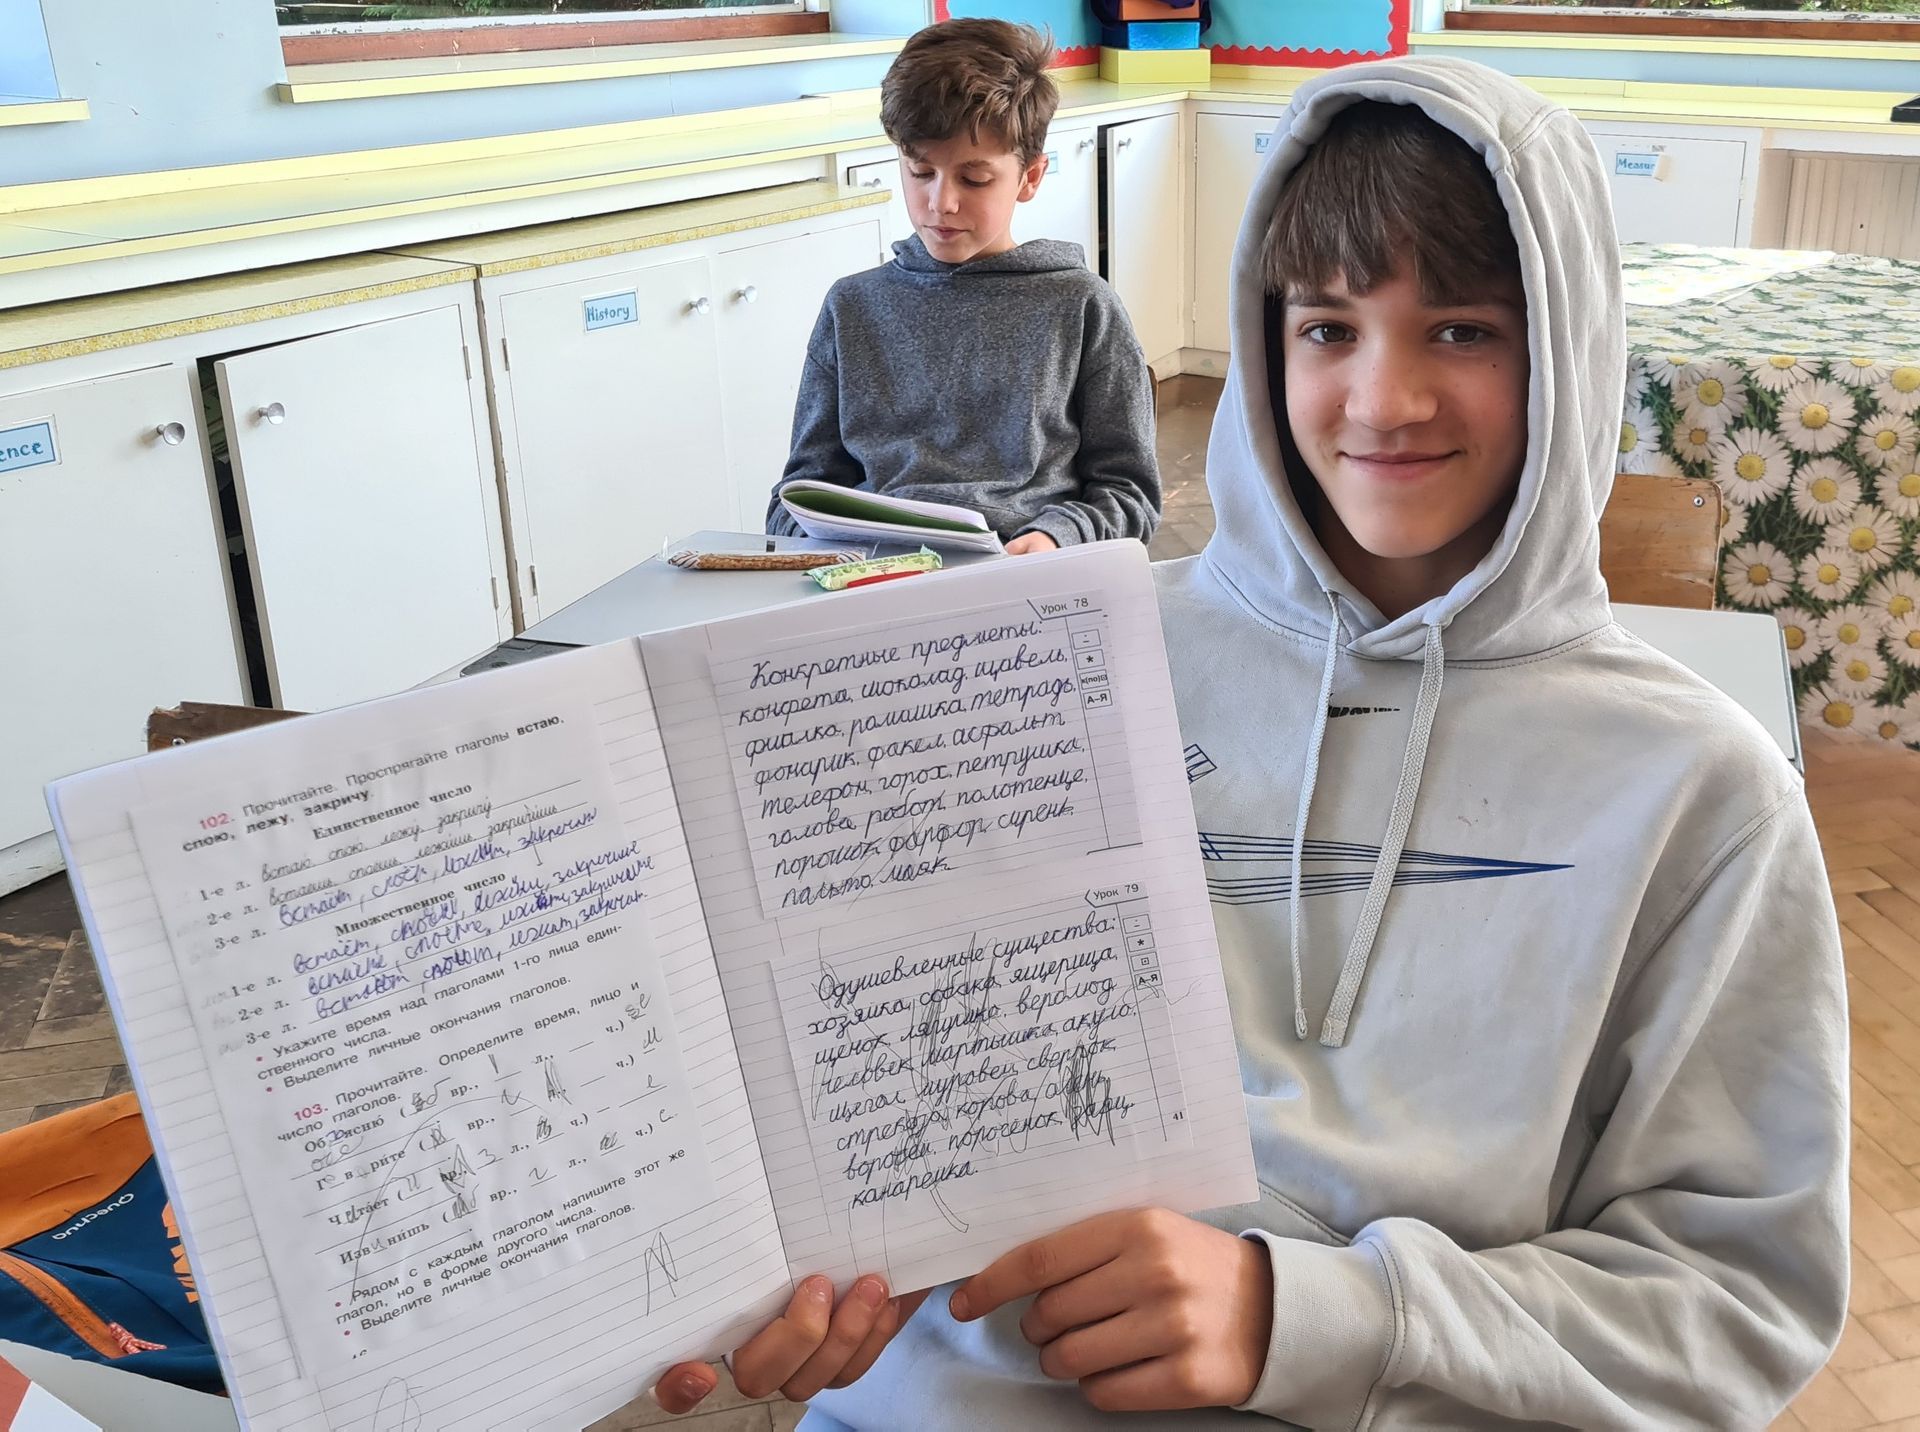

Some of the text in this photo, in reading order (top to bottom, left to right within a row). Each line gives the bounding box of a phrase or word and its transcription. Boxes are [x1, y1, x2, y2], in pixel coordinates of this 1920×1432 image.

[586, 306, 630, 322] History
[1041, 597, 1089, 615] Урок 78
[750, 621, 1043, 690] Конкретные предметы:
[200, 813, 235, 830] 102.
[243, 784, 337, 818] Прочитайте.
[346, 750, 448, 787] Проспрягайте
[455, 731, 510, 755] глаголы
[312, 784, 472, 840] Единственное число
[335, 889, 455, 938] Множественное
[464, 874, 505, 893] число
[1093, 883, 1139, 900] Урок 79
[993, 911, 1116, 967] существа:
[273, 1028, 337, 1058] Укажите
[346, 1009, 392, 1033] время
[400, 997, 428, 1013] над
[434, 967, 505, 1000] глаголами
[514, 953, 541, 970] 1-го
[548, 940, 580, 959] лица
[587, 925, 622, 943] един-
[257, 1028, 391, 1080] ственного числа.
[283, 974, 571, 1088] Выделите личные окончания глаголов.
[293, 1103, 329, 1120] 103.
[336, 1065, 428, 1105] Прочитайте.
[439, 1027, 524, 1066] Определите
[534, 1006, 580, 1030] время,
[590, 988, 621, 1008] лицо
[631, 981, 640, 991] и
[278, 1094, 401, 1142] число глаголов.
[1172, 1111, 1184, 1121] 41
[52, 1192, 134, 1240] Quechua
[352, 1149, 685, 1302] Рядом с каждым глаголом напишите этот же
[336, 1205, 597, 1325] глагол, но в форме другого числа.
[360, 1203, 636, 1331] Выделите личные окончания глаголов.
